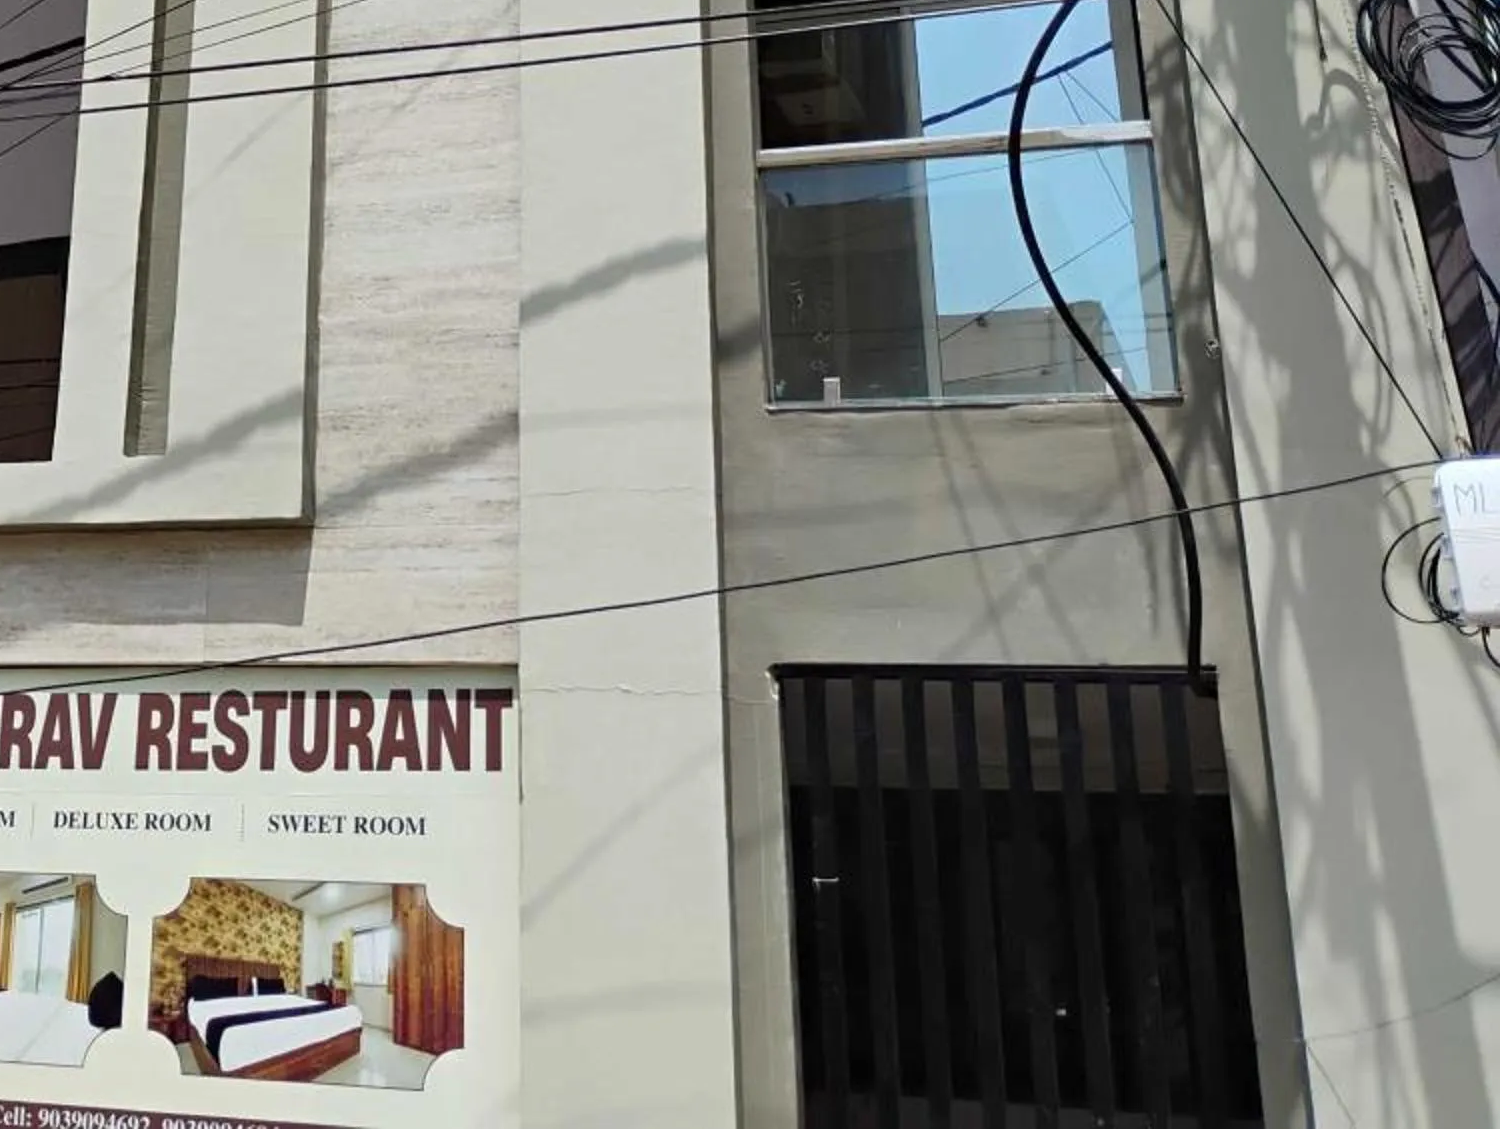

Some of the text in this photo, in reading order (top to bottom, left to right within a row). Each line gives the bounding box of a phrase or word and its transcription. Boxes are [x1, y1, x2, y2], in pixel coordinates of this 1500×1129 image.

[134, 687, 514, 773] RESTURANT
[53, 810, 213, 833] DELUXE ROOM
[267, 814, 427, 836] SWEET ROOM
